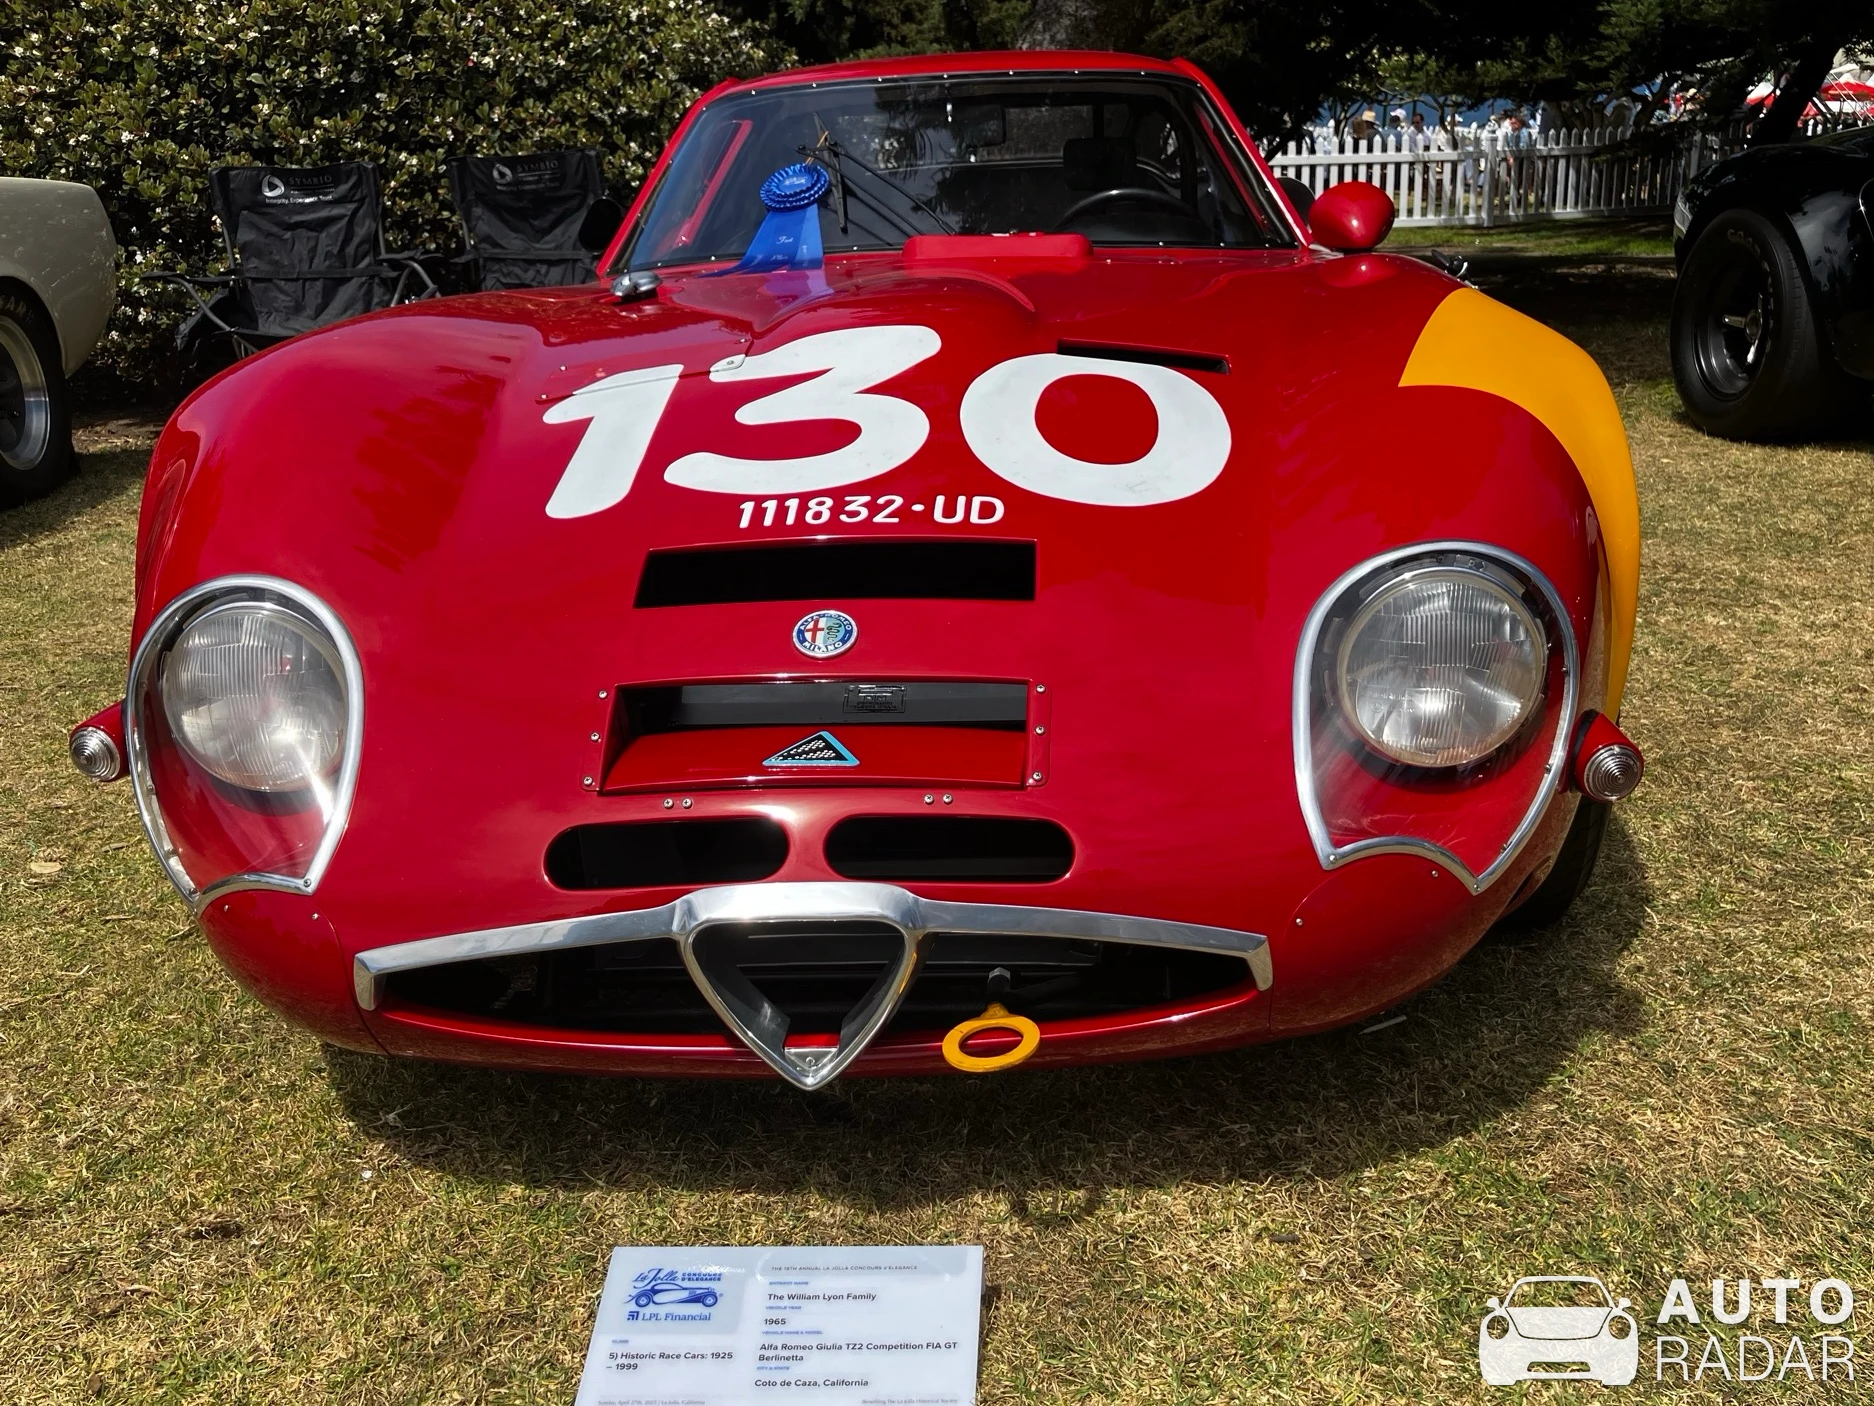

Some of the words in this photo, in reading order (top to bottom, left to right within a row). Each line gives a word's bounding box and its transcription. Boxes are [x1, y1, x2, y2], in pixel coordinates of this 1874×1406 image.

[542, 324, 1232, 519] 130
[802, 641, 843, 653] MILANO
[632, 1272, 649, 1282] La
[633, 1268, 680, 1289] Jolla
[822, 1293, 844, 1302] Lyon
[846, 1292, 877, 1301] Family
[641, 1312, 662, 1321] LPL
[664, 1312, 712, 1321] Financial
[759, 1343, 778, 1351] Alfa
[781, 1343, 814, 1351] Romeo
[866, 1342, 924, 1351] Competition
[609, 1352, 618, 1360] 5)
[620, 1352, 656, 1360] Historic
[659, 1352, 681, 1360] Race
[684, 1352, 708, 1360] Cars:
[754, 1379, 778, 1387] Coto
[780, 1379, 792, 1387] de
[794, 1379, 820, 1388] Caza,
